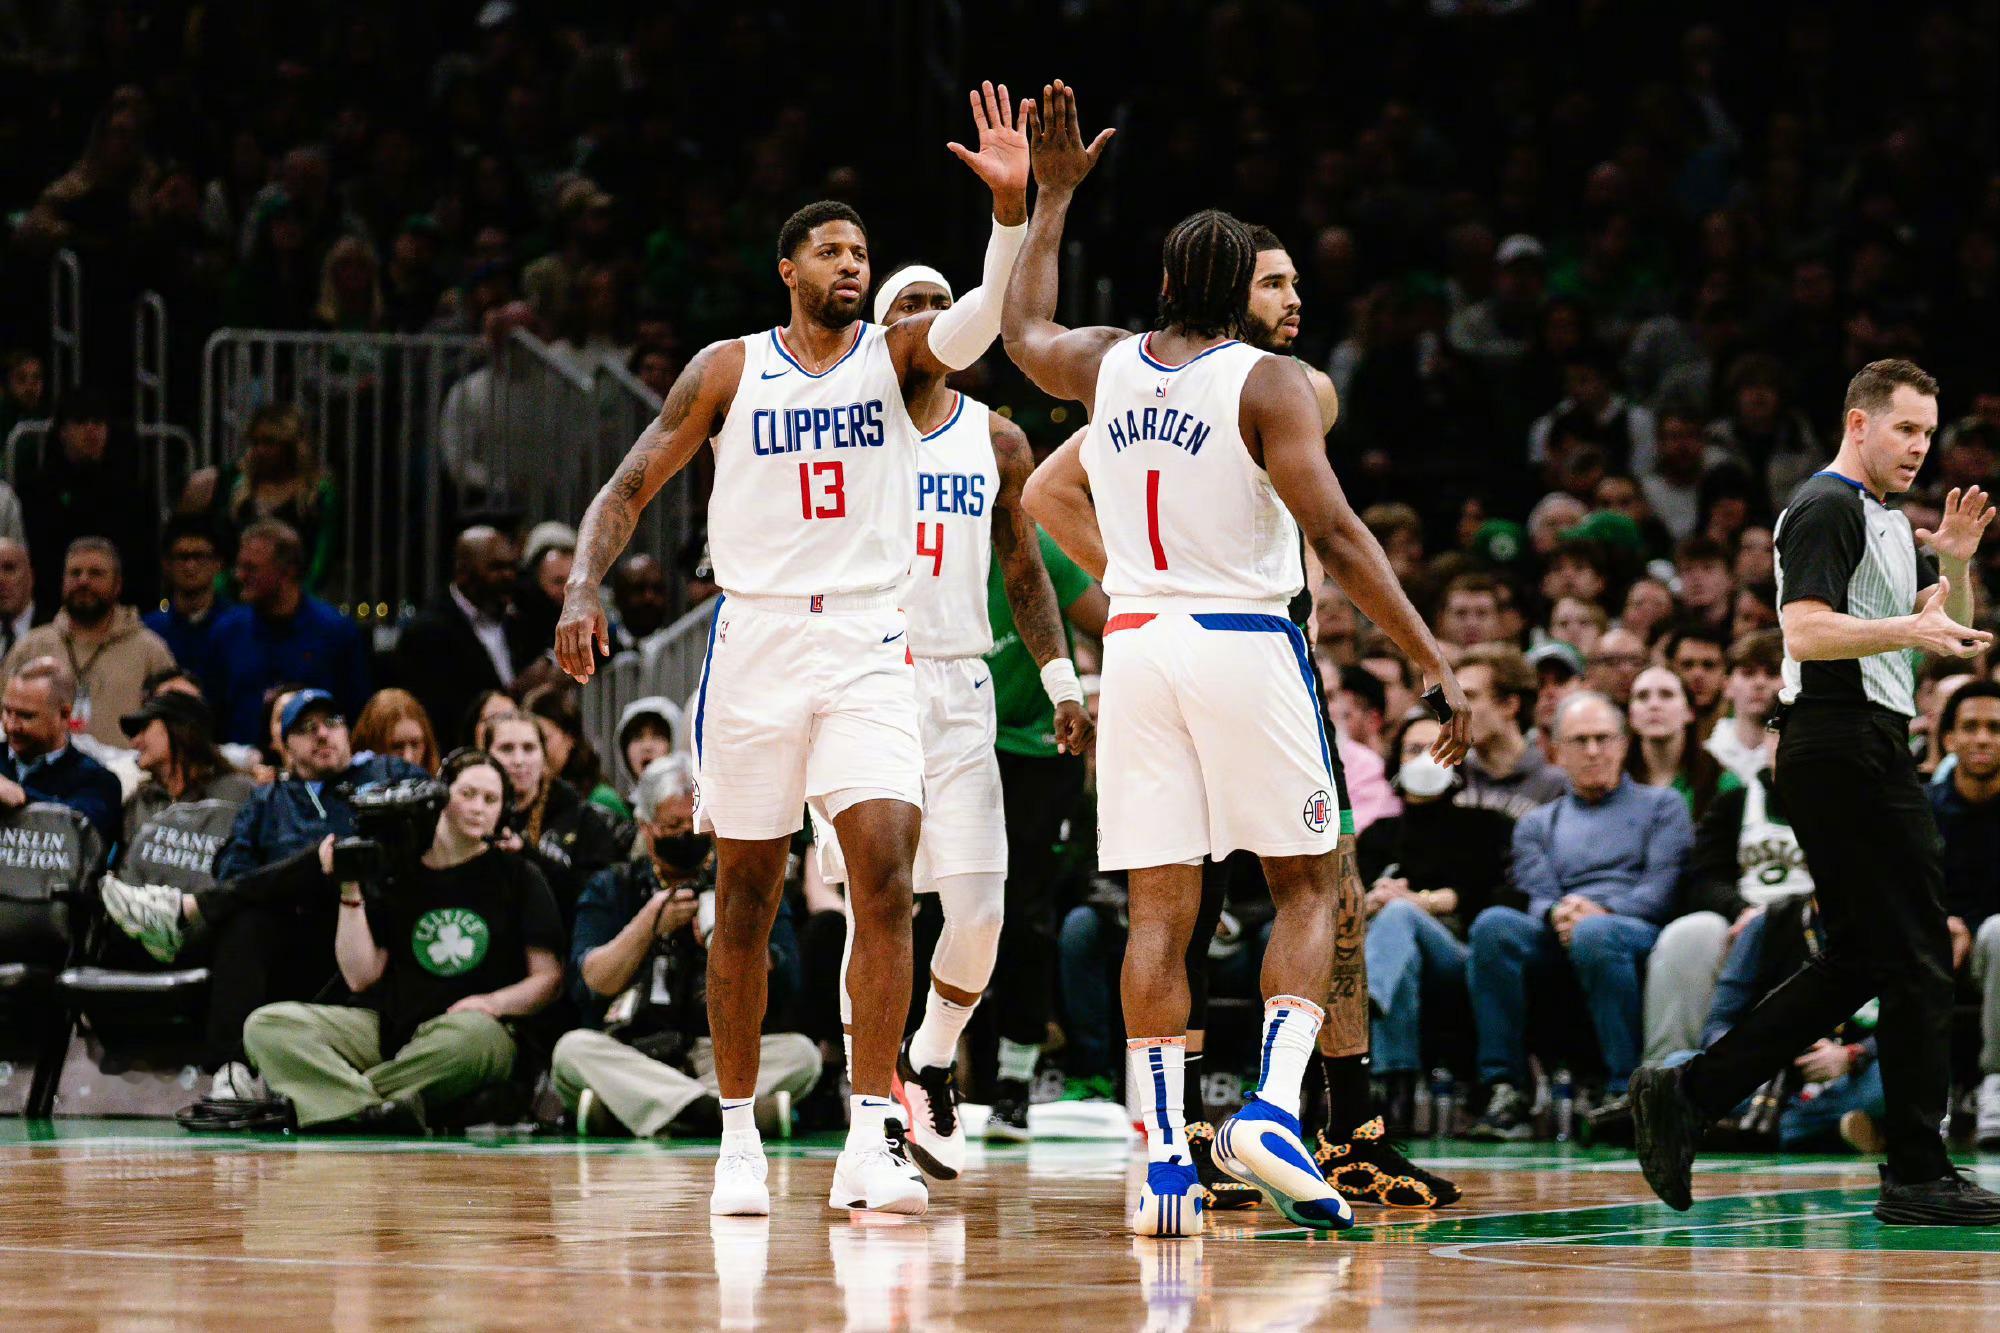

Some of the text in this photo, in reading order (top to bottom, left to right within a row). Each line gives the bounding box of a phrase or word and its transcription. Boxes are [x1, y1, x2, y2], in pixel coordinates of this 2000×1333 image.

[752, 398, 885, 456] CLIPPERS
[1107, 407, 1211, 456] HARDEN
[799, 460, 846, 520] 13
[917, 471, 985, 517] PERS
[1146, 469, 1169, 571] 1
[908, 521, 944, 577] 4
[415, 909, 485, 941] CELTICS
